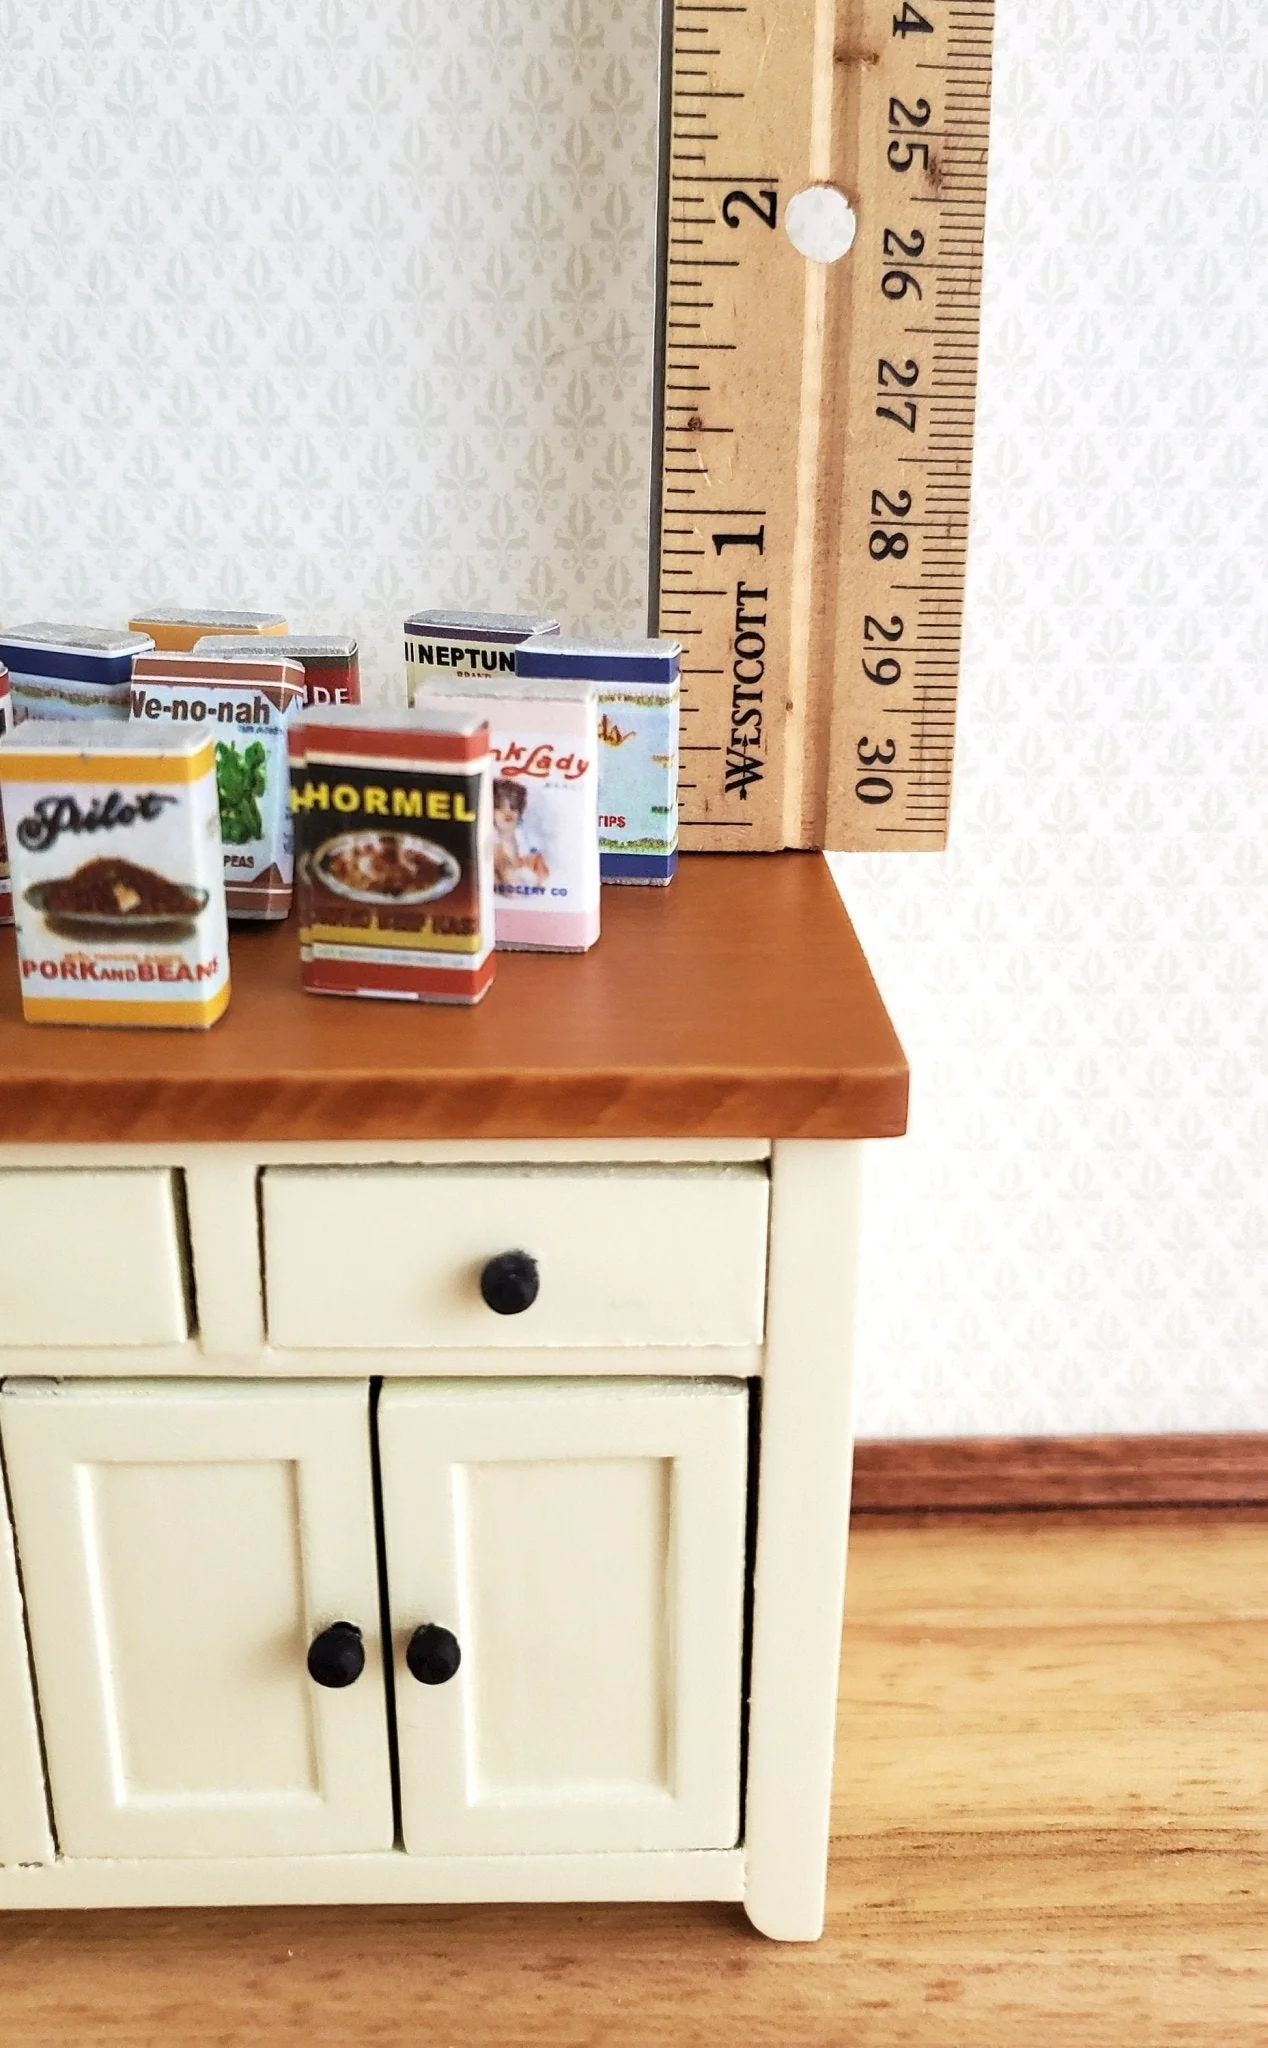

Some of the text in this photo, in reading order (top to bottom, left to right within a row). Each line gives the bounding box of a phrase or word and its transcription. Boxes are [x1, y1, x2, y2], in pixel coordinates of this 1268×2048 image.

[887, 97, 931, 172] 25
[722, 190, 778, 229] 2
[881, 228, 925, 300] 26
[876, 359, 919, 432] 27
[712, 525, 765, 555] 1
[869, 489, 912, 561] 28
[862, 615, 904, 686] 29
[725, 581, 768, 794] WESTCOTT
[501, 745, 589, 779] Lady
[855, 737, 896, 804] 30
[17, 789, 180, 852] Pilot
[304, 782, 476, 822] HORMEL
[223, 856, 254, 868] PEAS
